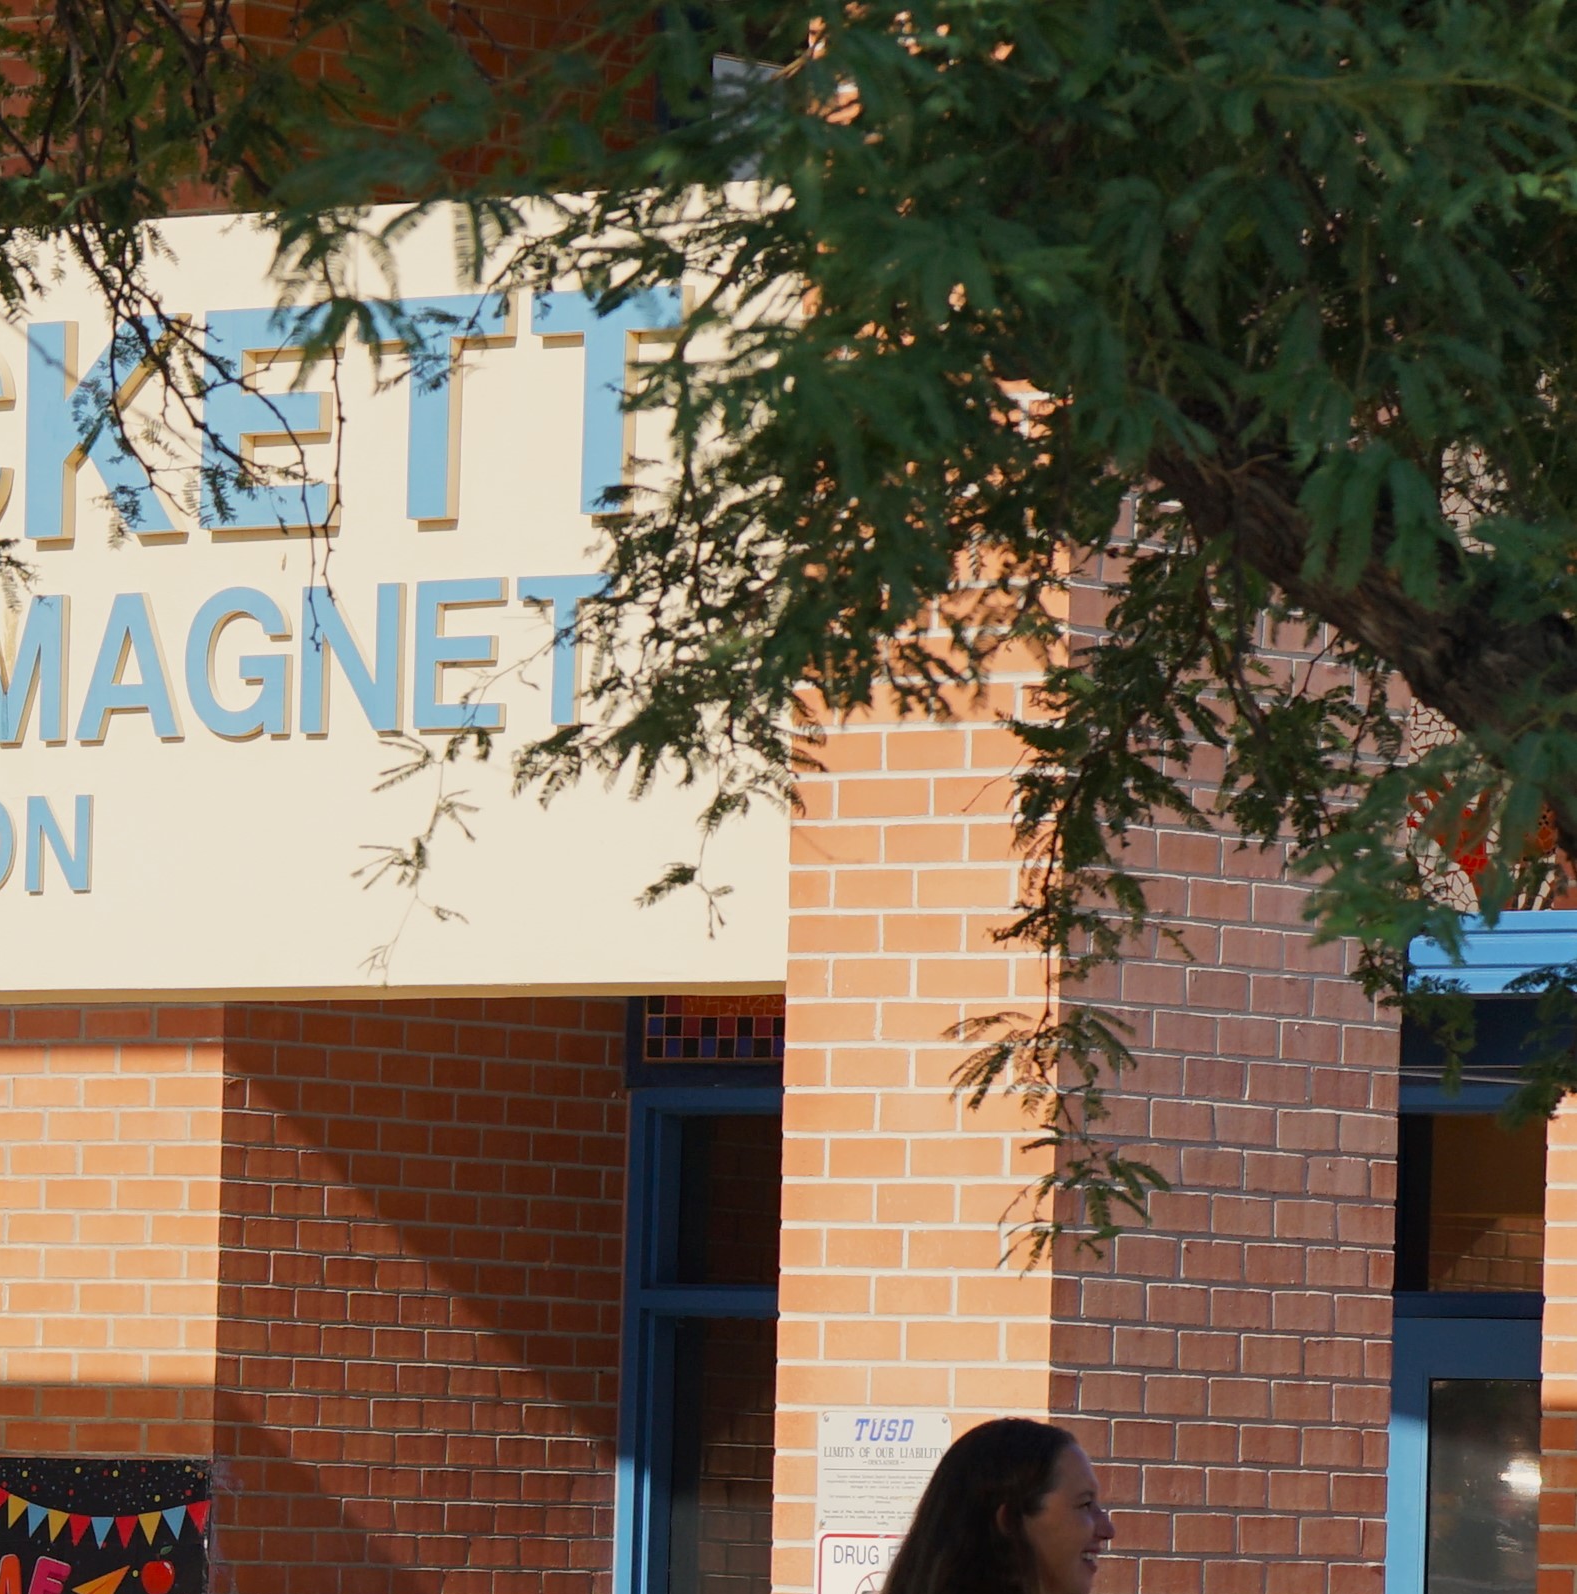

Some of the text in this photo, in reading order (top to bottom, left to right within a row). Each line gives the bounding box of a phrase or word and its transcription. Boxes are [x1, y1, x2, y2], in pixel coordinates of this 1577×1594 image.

[854, 1418, 915, 1442] TUSD
[823, 1446, 855, 1459] LIMITS
[859, 1446, 870, 1458] OF
[875, 1447, 894, 1458] OUR
[833, 1545, 879, 1565] DRUG
